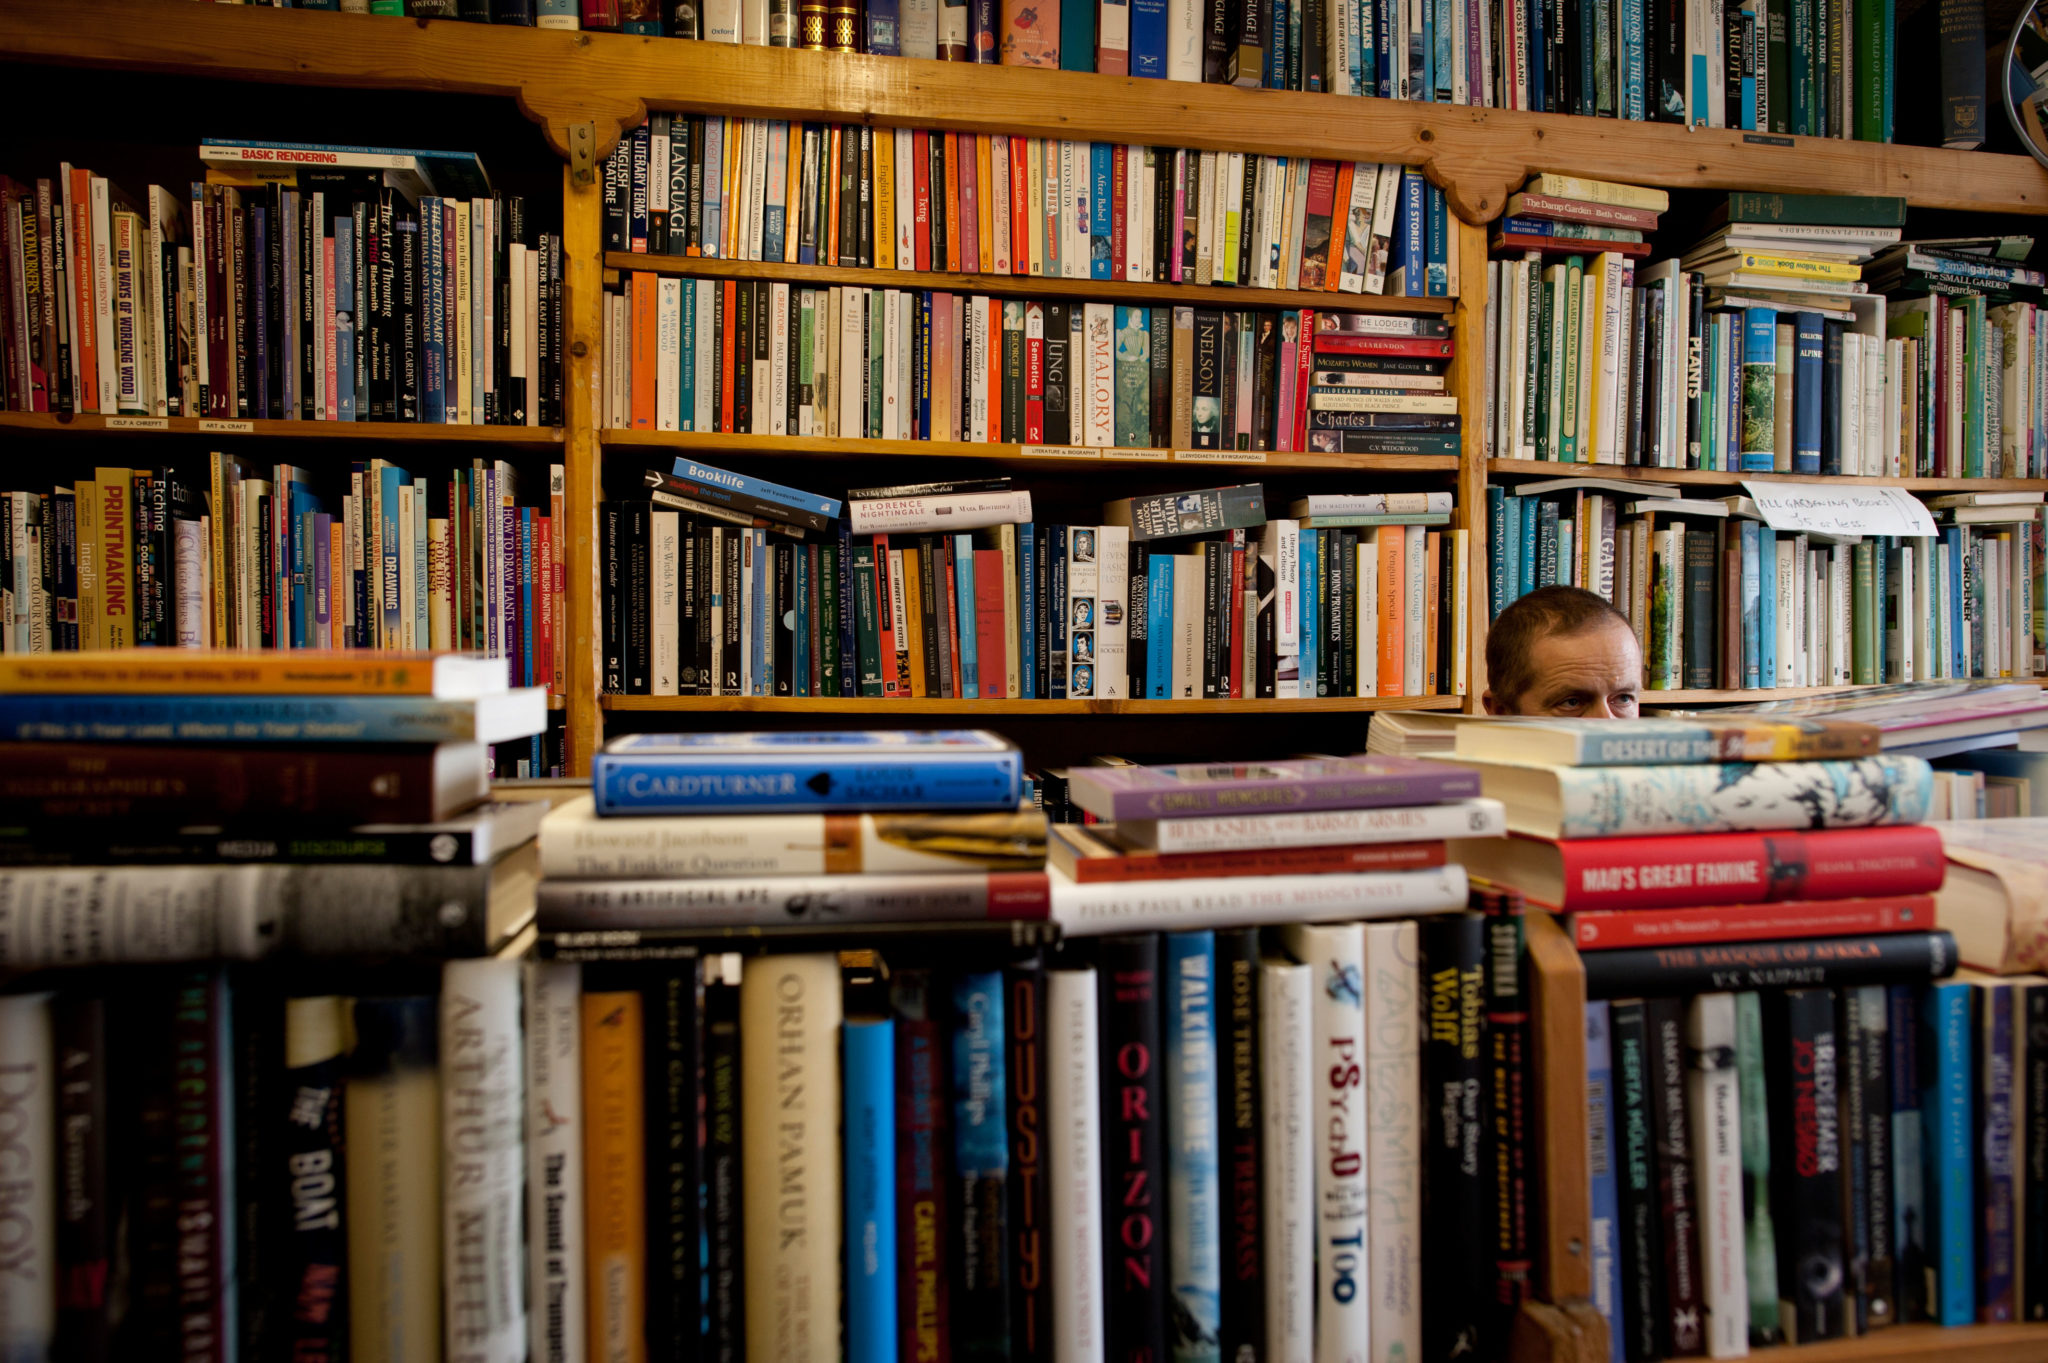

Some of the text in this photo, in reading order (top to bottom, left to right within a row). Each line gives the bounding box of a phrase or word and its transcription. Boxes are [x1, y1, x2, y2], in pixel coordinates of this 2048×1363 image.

[1274, 21, 1284, 81] LITERATURE
[1631, 44, 1640, 58] IN
[1631, 61, 1640, 83] THE
[1729, 22, 1741, 86] ARLOTT
[1757, 27, 1766, 124] FREDDIE TRUEMAN
[242, 150, 337, 164] BASIC RENDERING
[617, 140, 628, 187] ENGLISH
[633, 140, 646, 219] LITERARY TERMS
[40, 185, 49, 218] BROUN
[669, 142, 686, 238] LANGUAGE
[879, 165, 888, 245] English Literature
[917, 198, 928, 222] Txtng
[1097, 198, 1106, 221] Babel
[457, 214, 467, 242] Pottery
[1410, 182, 1419, 251] LOVE STORIES
[54, 218, 65, 270] Woodcarving
[381, 205, 394, 317] The Art of Throwing
[431, 231, 442, 276] POTTER'S
[539, 235, 547, 265] GLAZES
[41, 236, 54, 326] Woodwork now
[370, 264, 379, 311] Blacksmith
[403, 234, 413, 306] PIONEER POTTERY
[458, 271, 468, 301] making
[539, 281, 547, 299] THE
[118, 250, 134, 395] OLD WAYS OF WORKING WOOD
[326, 288, 336, 372] SCULPTURE TECHNIQUES
[432, 279, 443, 345] DICTIONARY
[539, 301, 547, 326] CRAFT
[1375, 319, 1408, 328] LODGER
[539, 328, 547, 358] POTTER
[1011, 331, 1019, 366] GEORGE
[1031, 341, 1039, 389] Semiotics
[1046, 338, 1068, 383] JUNG
[1199, 325, 1214, 395] NELSON
[1300, 314, 1312, 369] Muriel Spark
[1096, 340, 1109, 432] MALORY
[1688, 336, 1701, 399] PLANTS
[1732, 366, 1740, 402] MOON
[1316, 411, 1365, 429] Charles
[1991, 418, 2000, 462] HYBRIDS
[689, 465, 745, 489] Booklife
[14, 499, 24, 549] PRINTS
[152, 480, 165, 531] Etching
[860, 508, 925, 518] NIGHTINGALE
[863, 501, 922, 511] FLORENCE
[1153, 499, 1162, 536] HITLER
[1165, 497, 1179, 535] STALIN
[78, 542, 96, 589] intaglio
[104, 485, 125, 615] PRINTMAKING
[140, 504, 150, 620] ARTIST'S COLOUR MANUAL
[503, 508, 515, 622] HOW TO DRAW PLANTS
[664, 553, 673, 579] Wields
[1318, 536, 1326, 575] Peripheral
[155, 581, 164, 622] Alan Smith
[384, 556, 397, 610] DRAWING
[417, 540, 426, 620] THE DRAWING BOOK
[664, 591, 673, 605] Pen
[1963, 556, 1971, 621] GARDENER
[1331, 570, 1341, 642] DOING PRAGMATICS
[1601, 738, 1669, 761] DESERT
[626, 772, 797, 799] CARDTURNER
[1582, 861, 1760, 892] MAO'S GREAT FAMINE
[1430, 967, 1459, 1045] Wolff
[1460, 963, 1484, 1060] Tobias
[288, 1149, 340, 1232] BOAT
[777, 1121, 807, 1251] PAMUK
[915, 1271, 938, 1362] PHILLIPS
